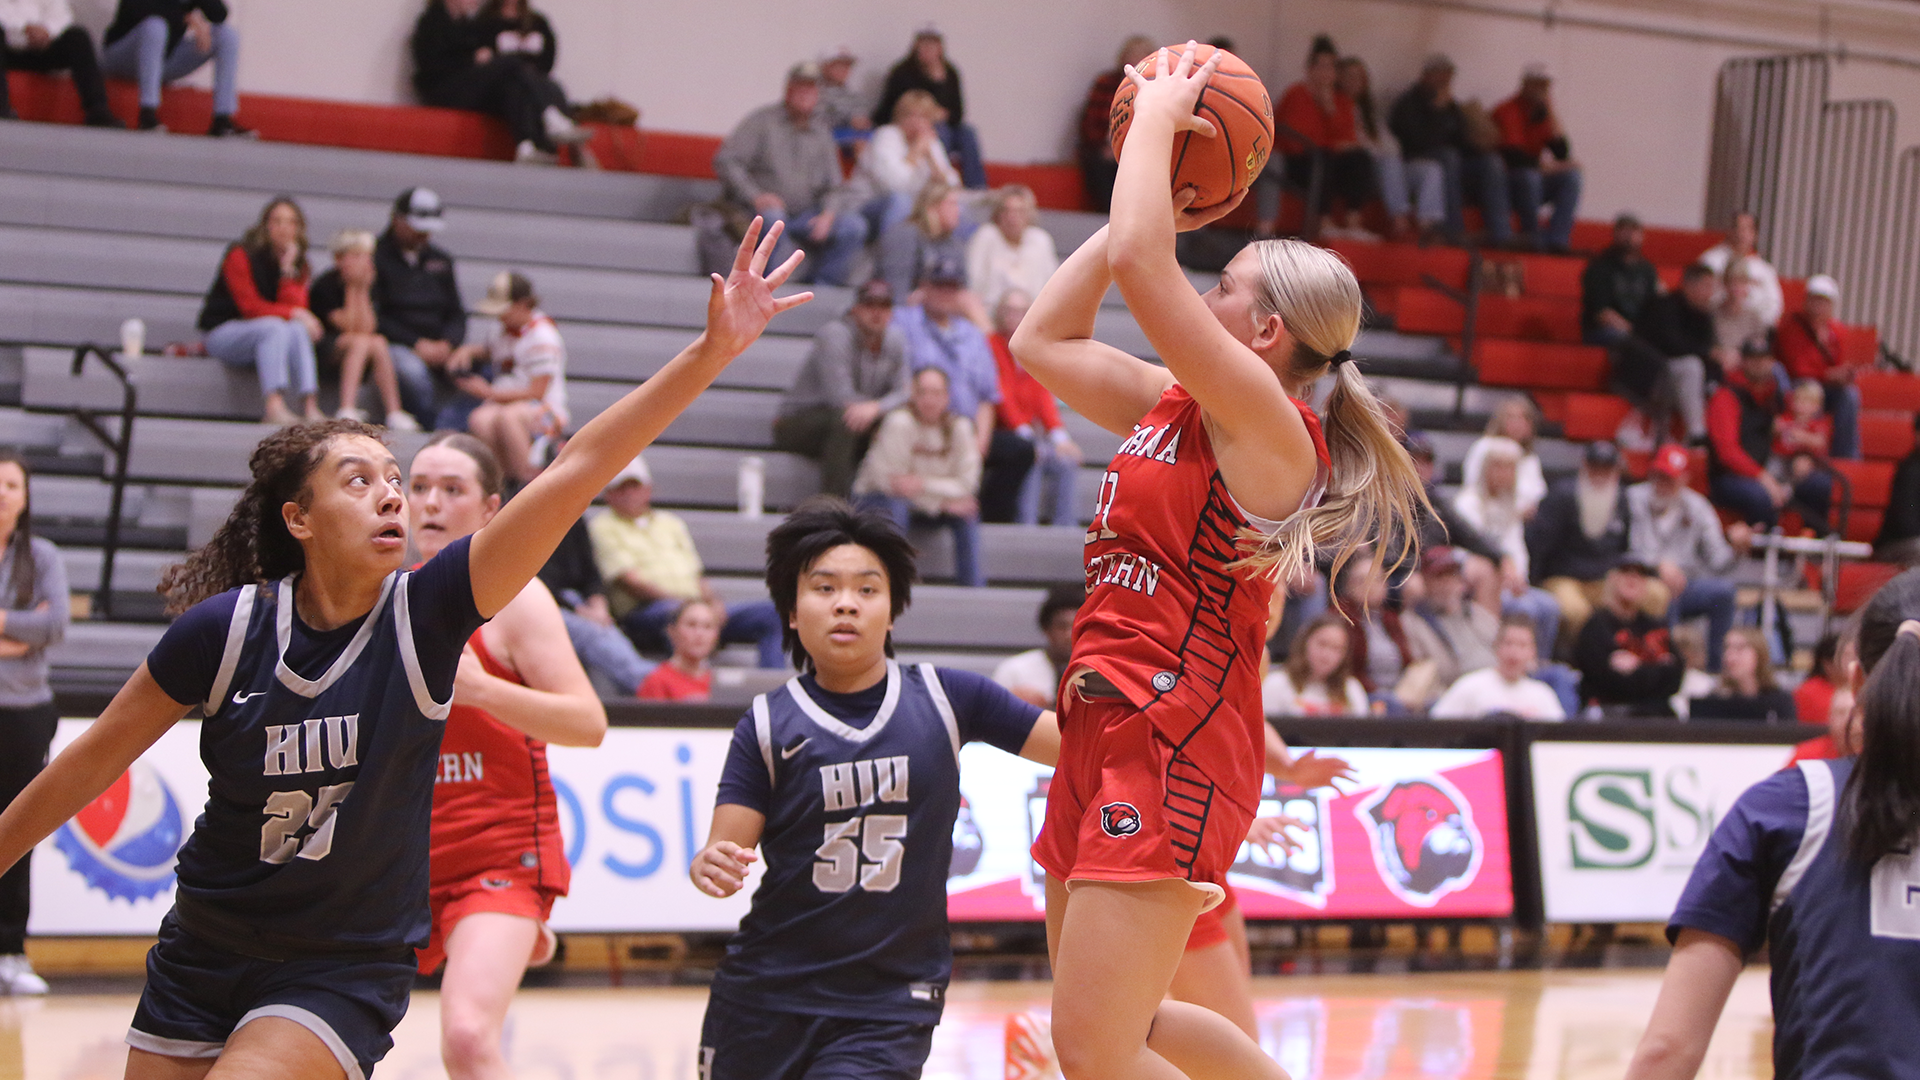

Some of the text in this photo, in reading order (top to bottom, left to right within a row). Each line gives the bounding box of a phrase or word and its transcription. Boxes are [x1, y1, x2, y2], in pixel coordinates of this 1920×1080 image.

[263, 713, 360, 776] HIU
[819, 755, 909, 812] HIU
[259, 781, 356, 864] 25
[812, 814, 908, 893] 55
